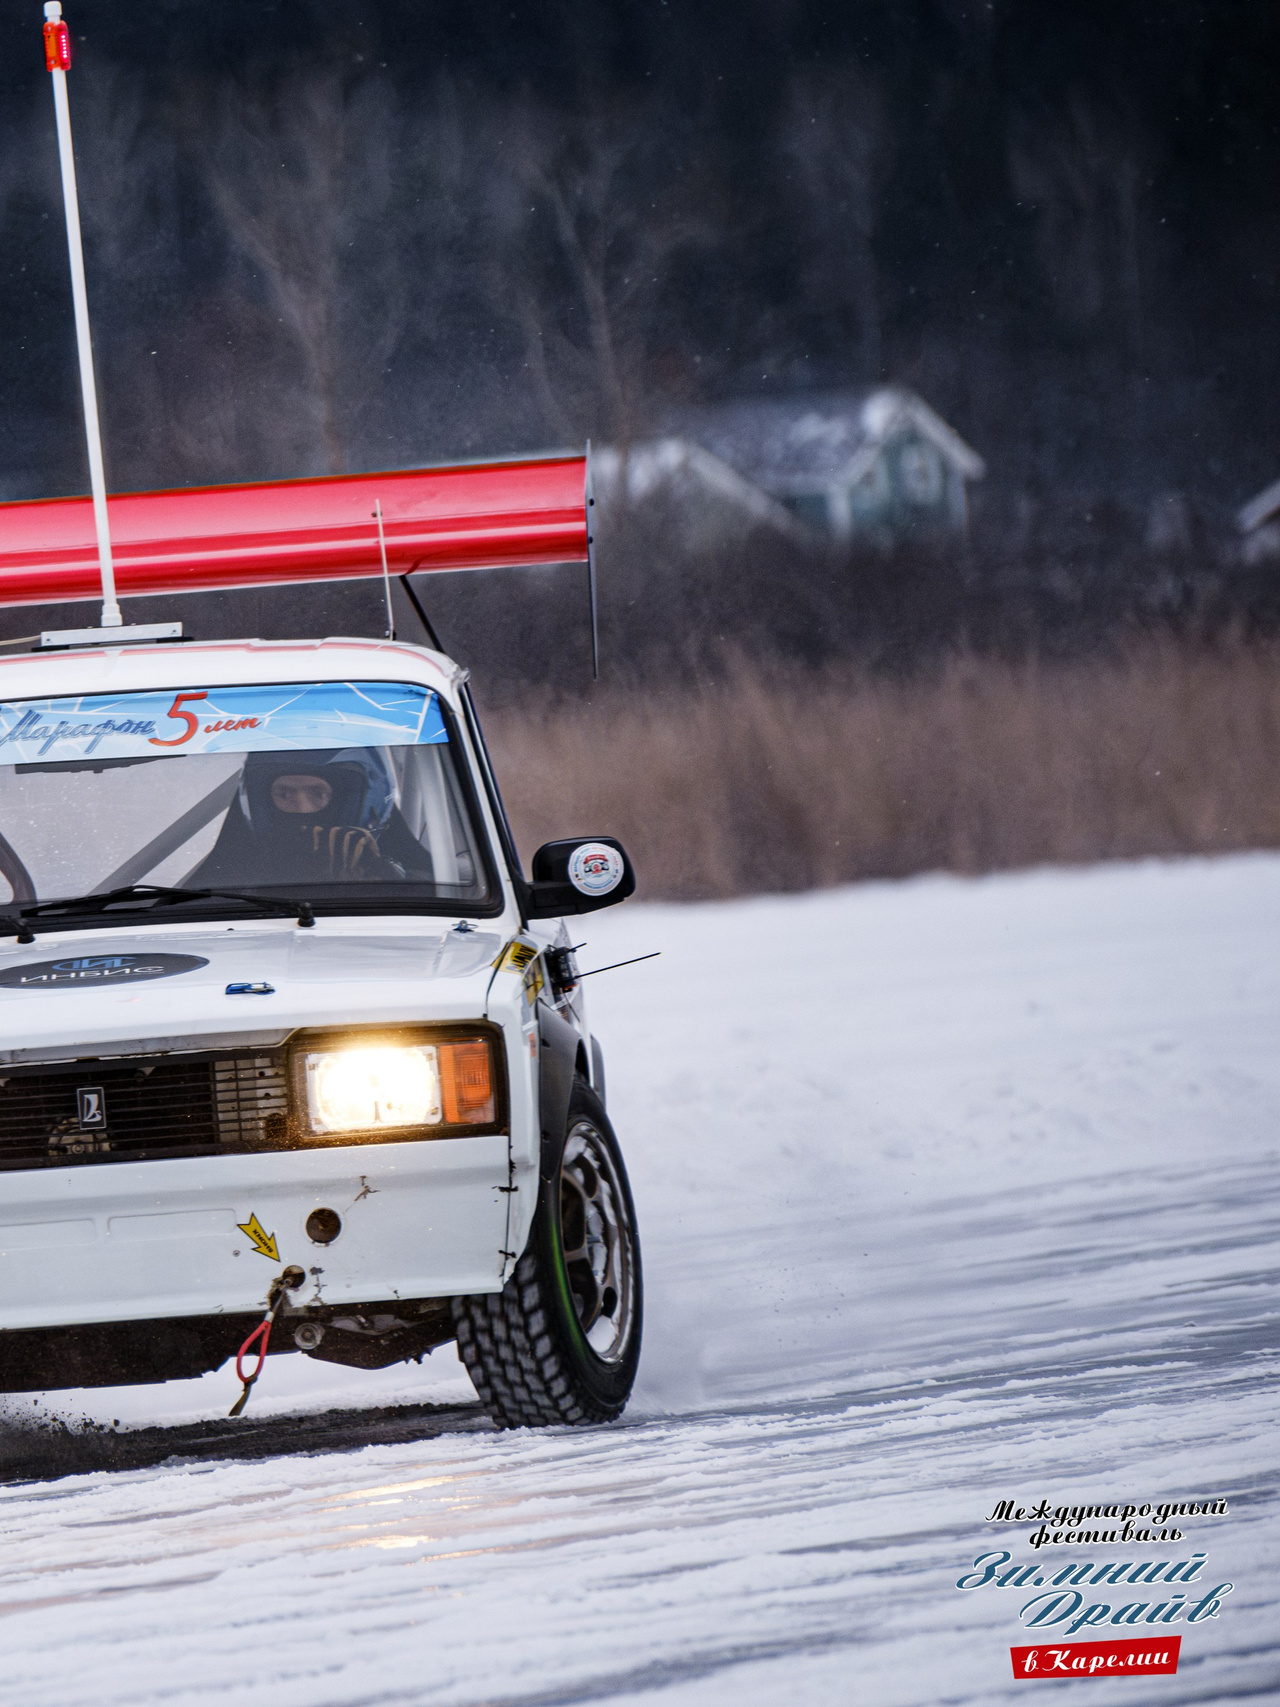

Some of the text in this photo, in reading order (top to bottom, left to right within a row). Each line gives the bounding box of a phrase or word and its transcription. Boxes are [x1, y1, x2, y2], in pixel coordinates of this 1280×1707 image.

[148, 691, 208, 747] 5
[204, 716, 262, 734] лет
[21, 966, 165, 983] ИНБИС
